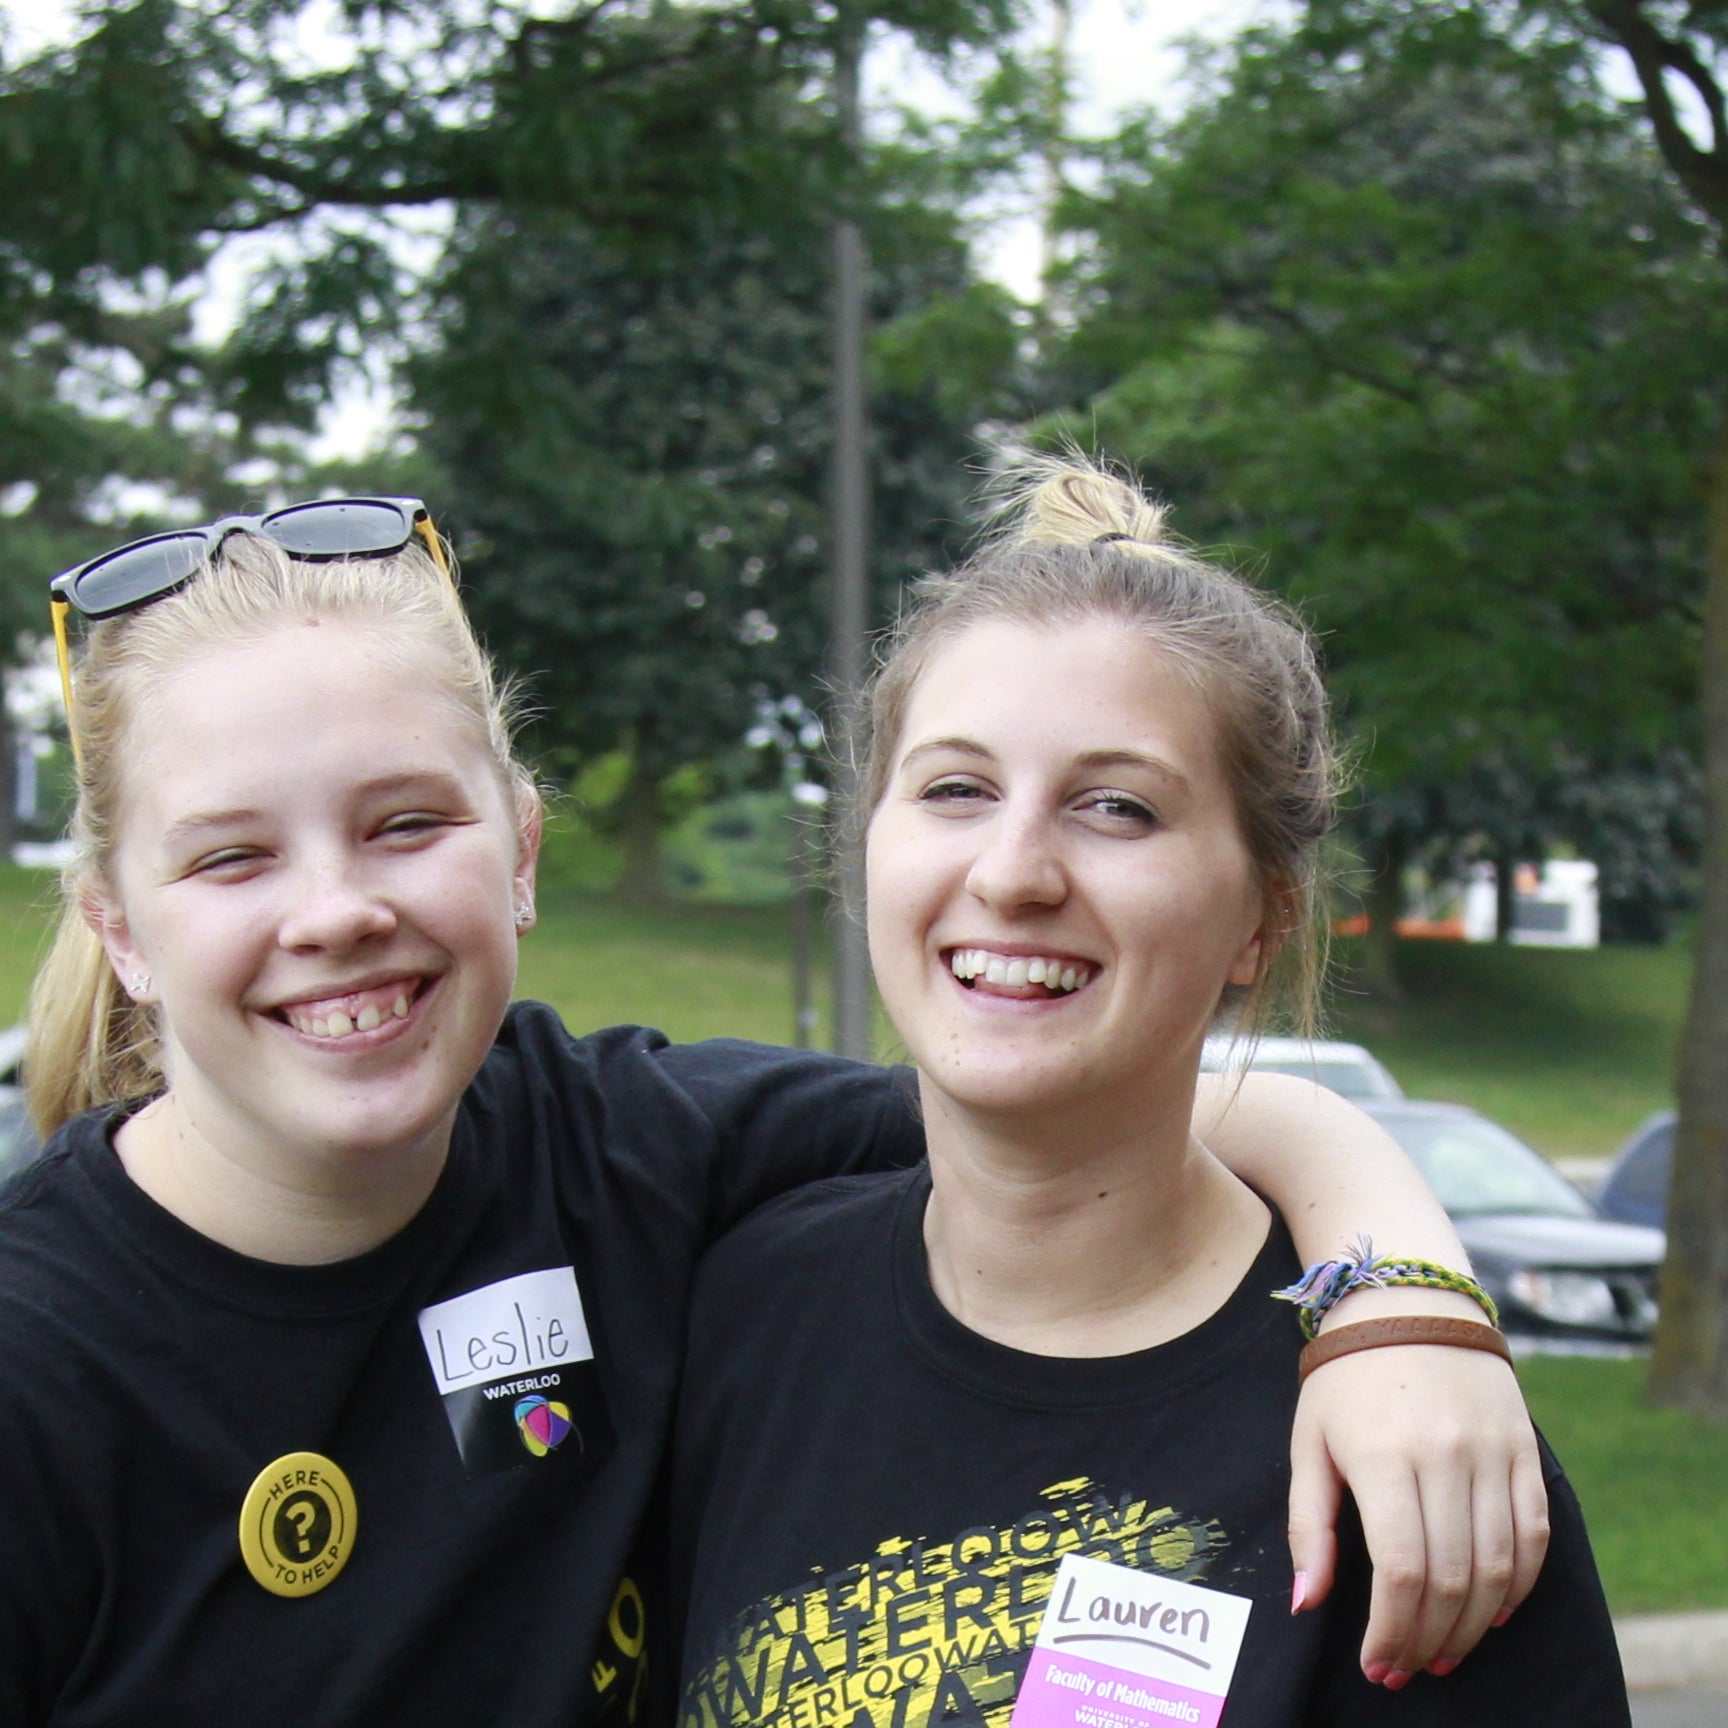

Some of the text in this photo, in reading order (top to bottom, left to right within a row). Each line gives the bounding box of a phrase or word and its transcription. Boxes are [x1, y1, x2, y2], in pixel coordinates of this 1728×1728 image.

[436, 1302, 569, 1382] Leslie
[483, 1373, 561, 1400] WATERLOO
[269, 1470, 320, 1500] HERE
[285, 1501, 316, 1554] ?
[275, 1545, 340, 1584] TO HELP
[1057, 1577, 1210, 1643] Lauren
[1044, 1664, 1201, 1724] Faculty of Mathematics
